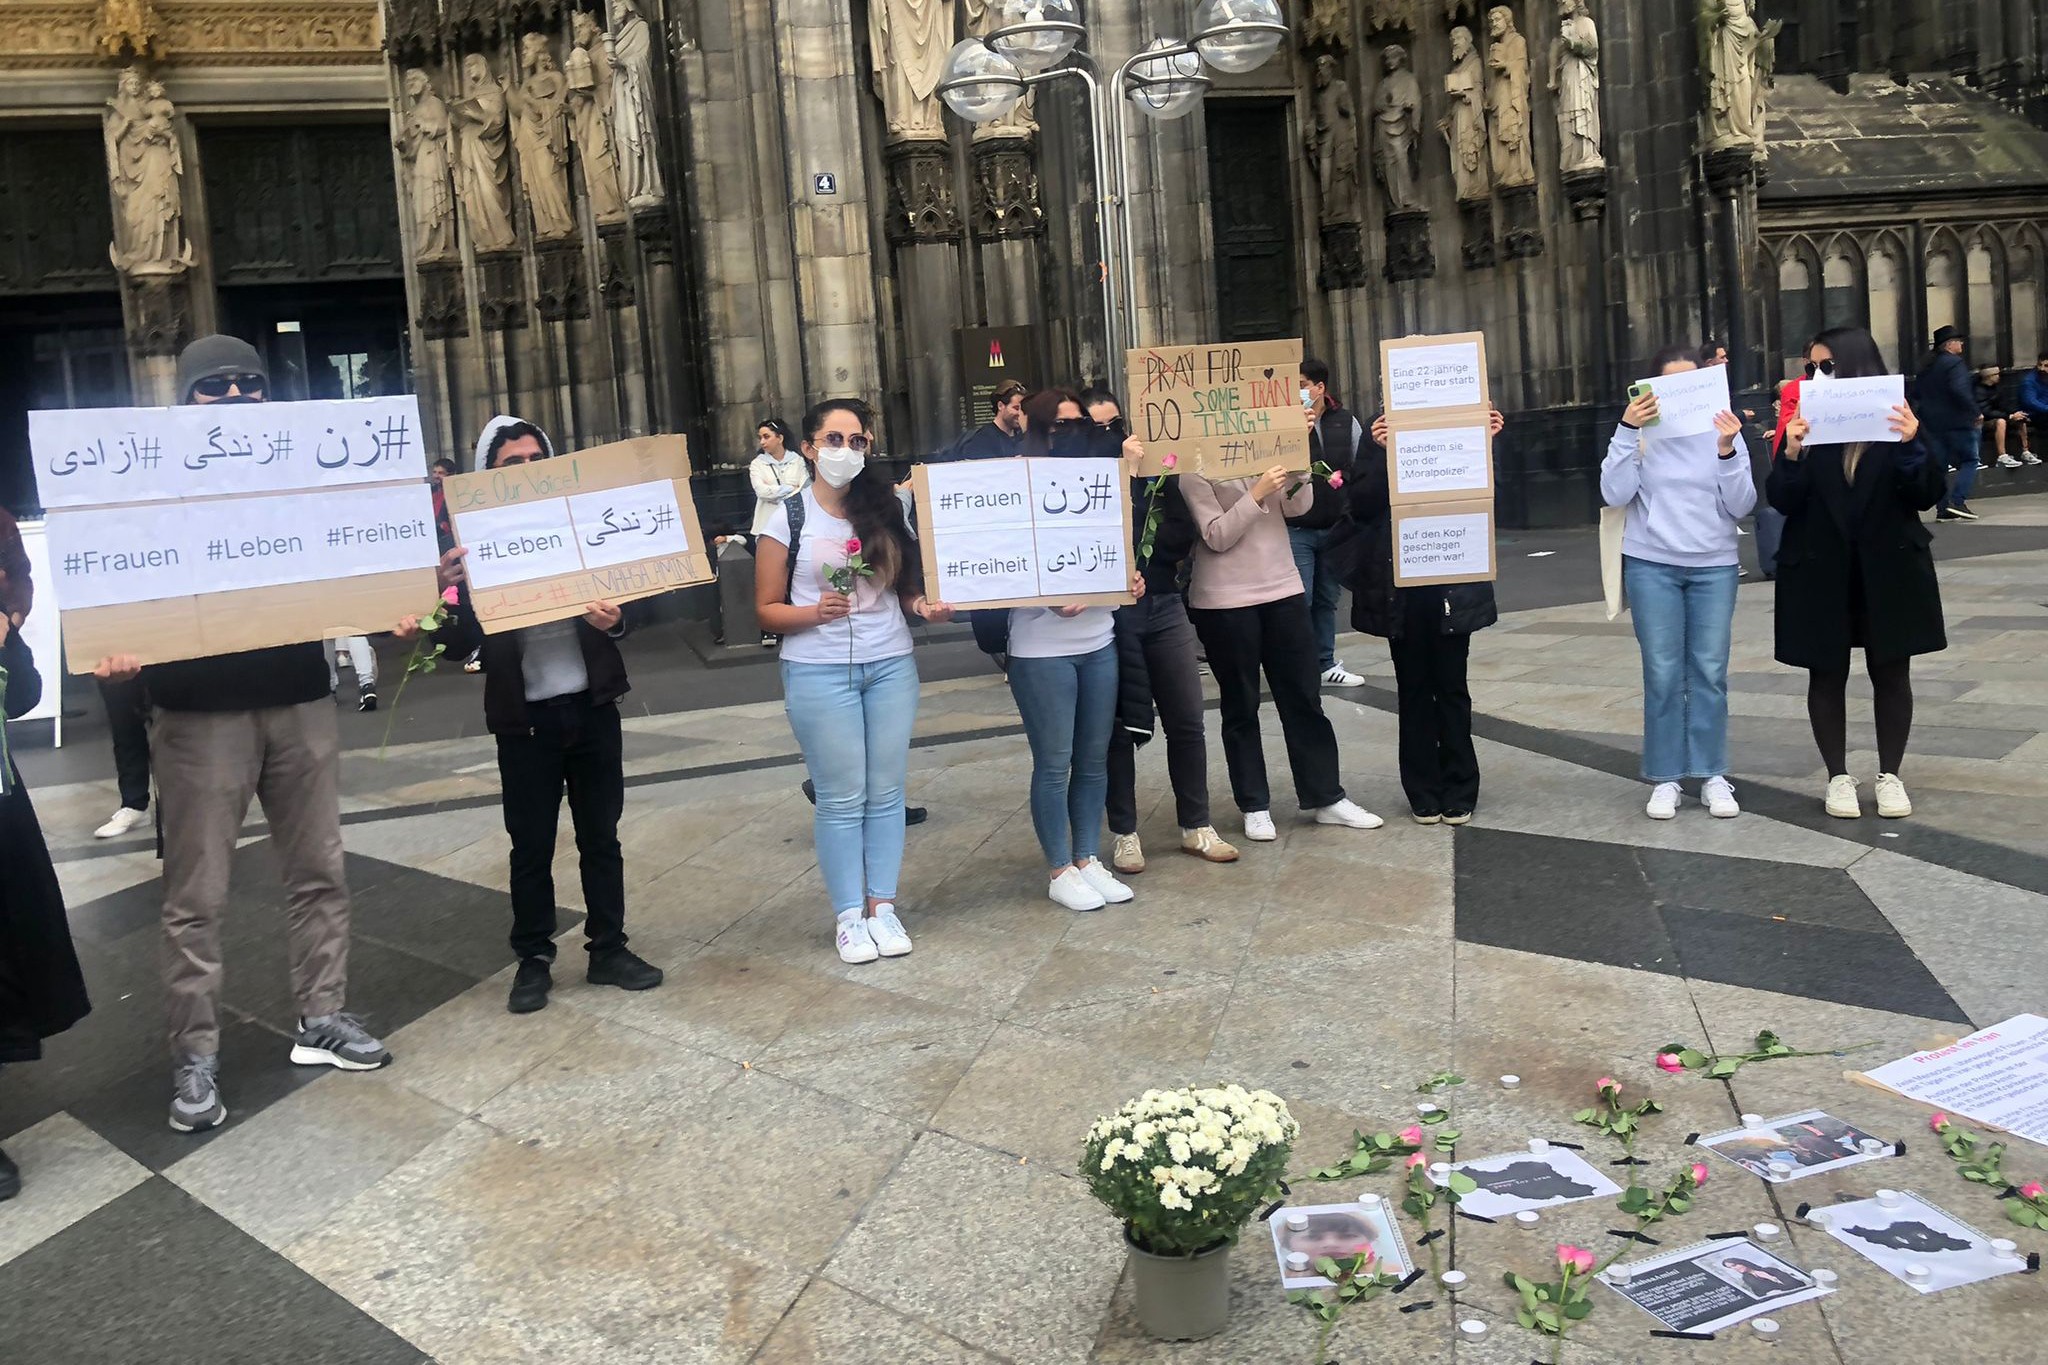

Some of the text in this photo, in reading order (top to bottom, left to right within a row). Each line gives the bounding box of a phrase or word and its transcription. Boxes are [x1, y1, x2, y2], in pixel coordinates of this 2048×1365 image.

[819, 176, 829, 189] 4
[1147, 348, 1244, 393] PRAY FOR
[1393, 364, 1468, 377] Eine 22-jährige
[1248, 377, 1291, 408] IRAN
[1393, 375, 1475, 391] junge Frau starb
[1191, 387, 1240, 413] SOME
[1146, 398, 1181, 442] DO
[1257, 411, 1270, 431] 4
[49, 415, 411, 476] #زن #زندگی #آزادی
[1399, 442, 1464, 454] nachdem sie
[1400, 455, 1439, 467] von der
[453, 459, 580, 509] Be Our Voice!
[1043, 473, 1112, 515] #زن
[940, 491, 1022, 510] #Frauen
[586, 503, 675, 546] #زندگی
[1403, 527, 1467, 540] auf den Kopf
[64, 519, 427, 576] #Frauen #Leben #Freiheit
[478, 533, 563, 561] #Leben
[1047, 540, 1118, 573] #آزادی
[1403, 541, 1460, 554] geschlagen
[947, 556, 1028, 577] #Freiheit
[1403, 552, 1465, 564] worden war!
[1913, 1046, 1960, 1063] Protest
